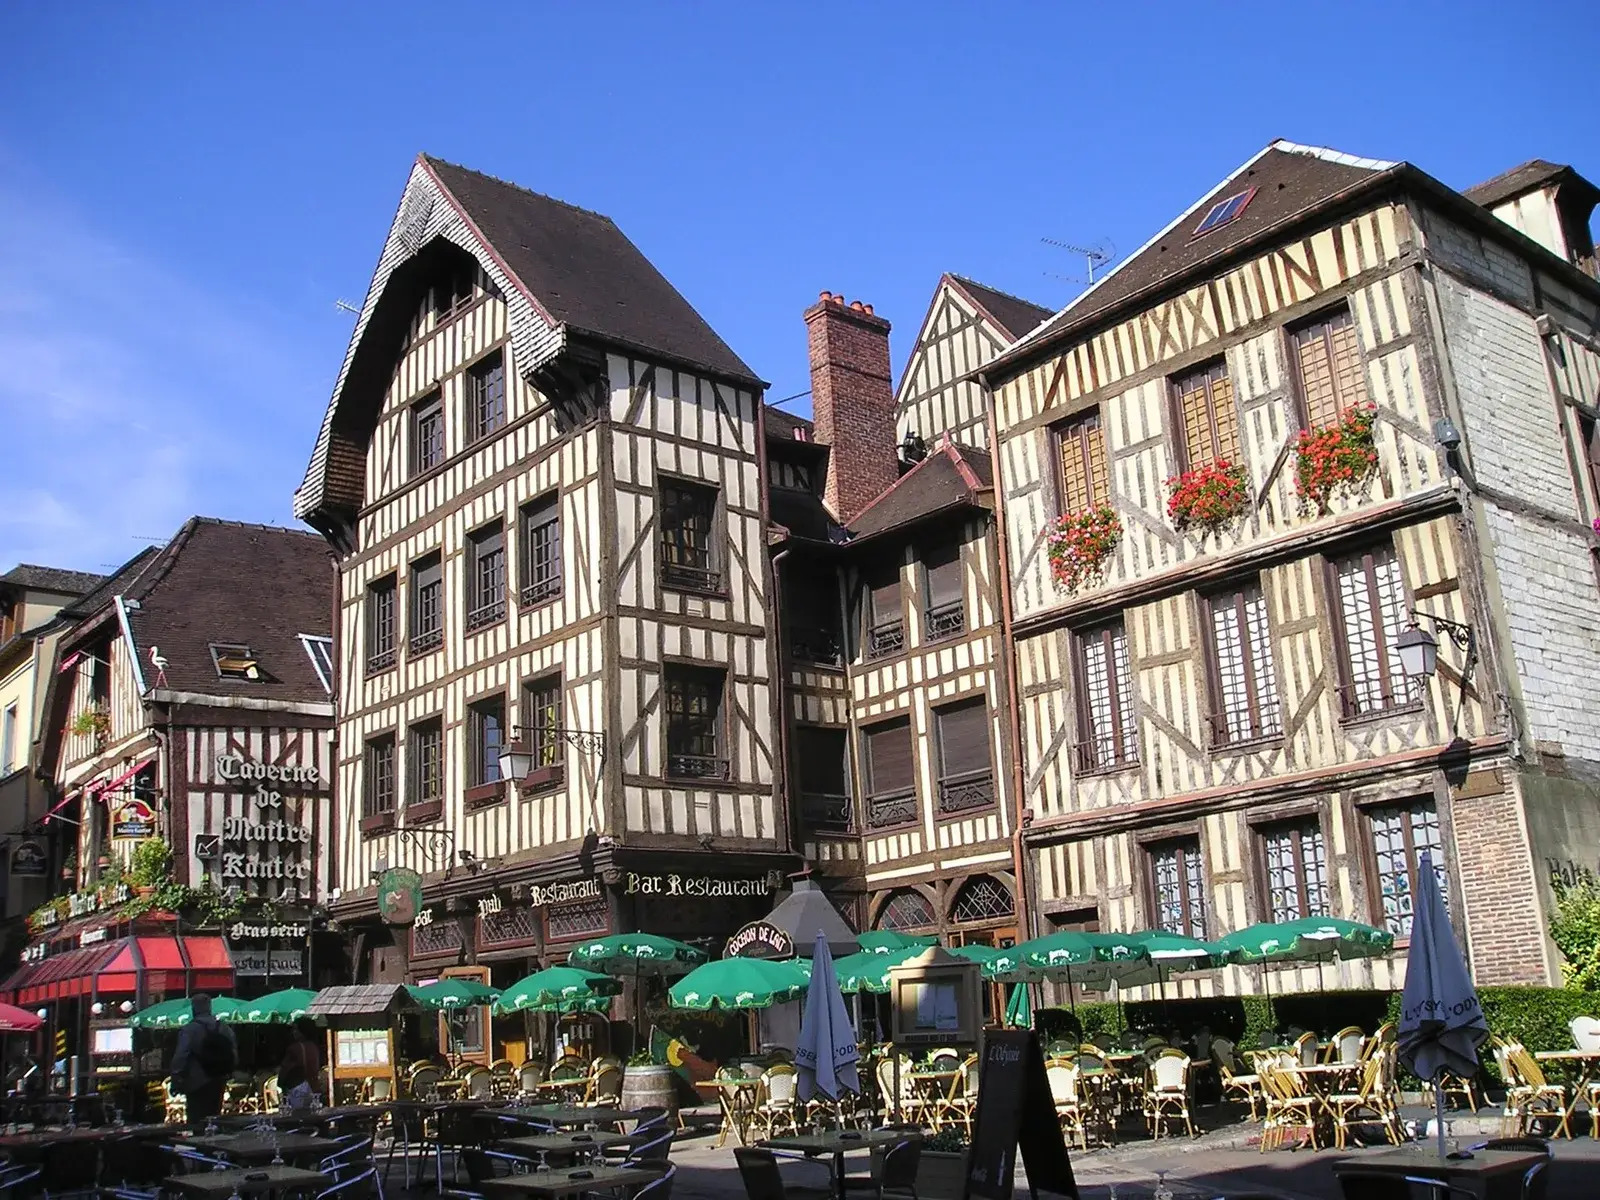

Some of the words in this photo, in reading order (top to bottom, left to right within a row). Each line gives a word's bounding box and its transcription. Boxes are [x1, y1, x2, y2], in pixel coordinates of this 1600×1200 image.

[217, 754, 320, 783] Taverne
[254, 783, 282, 809] de
[222, 852, 310, 880] Kanter
[530, 878, 600, 908] Restaurant
[623, 871, 663, 896] Bar
[665, 873, 769, 897] Restaurant
[230, 921, 307, 941] Brasserie
[729, 926, 757, 957] COCHON
[758, 926, 771, 943] DE
[768, 929, 787, 953] LAIT
